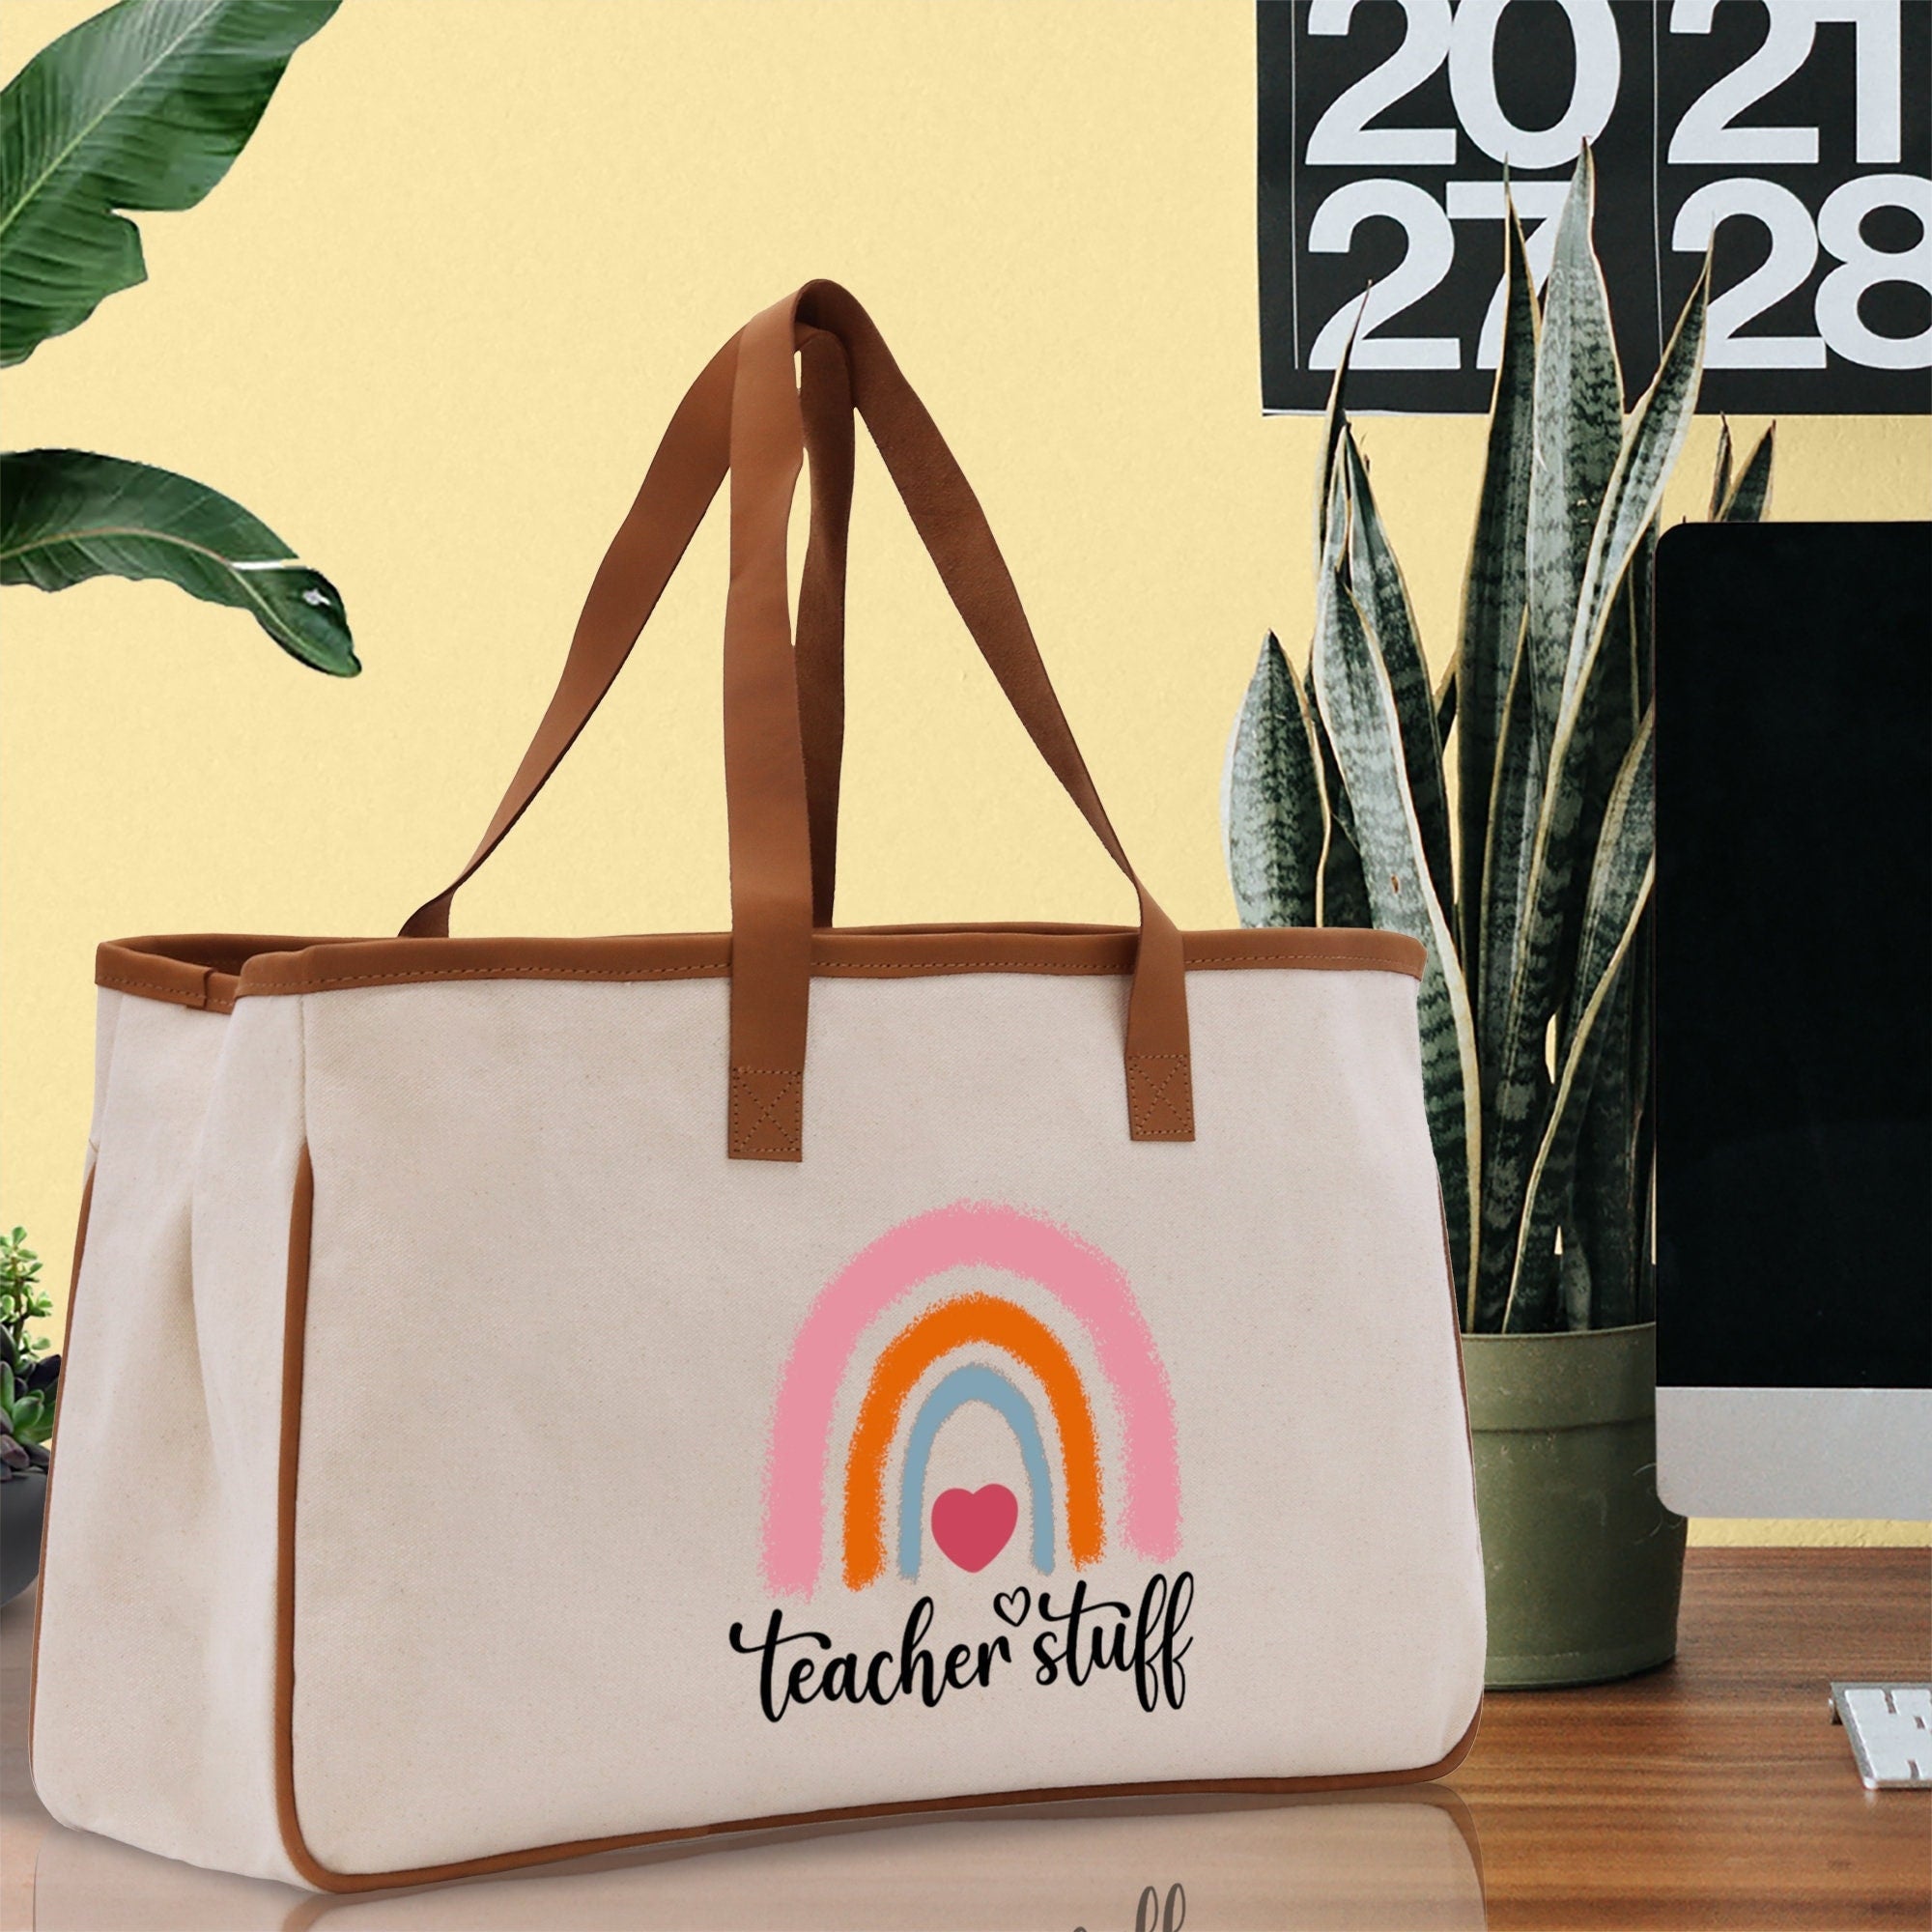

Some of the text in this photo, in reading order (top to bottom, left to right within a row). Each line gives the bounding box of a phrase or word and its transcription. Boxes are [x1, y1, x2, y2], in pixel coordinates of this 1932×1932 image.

[1304, 0, 1902, 170] 20 21
[1669, 174, 1932, 370] 28
[728, 1571, 1195, 1723] teacher stuff
